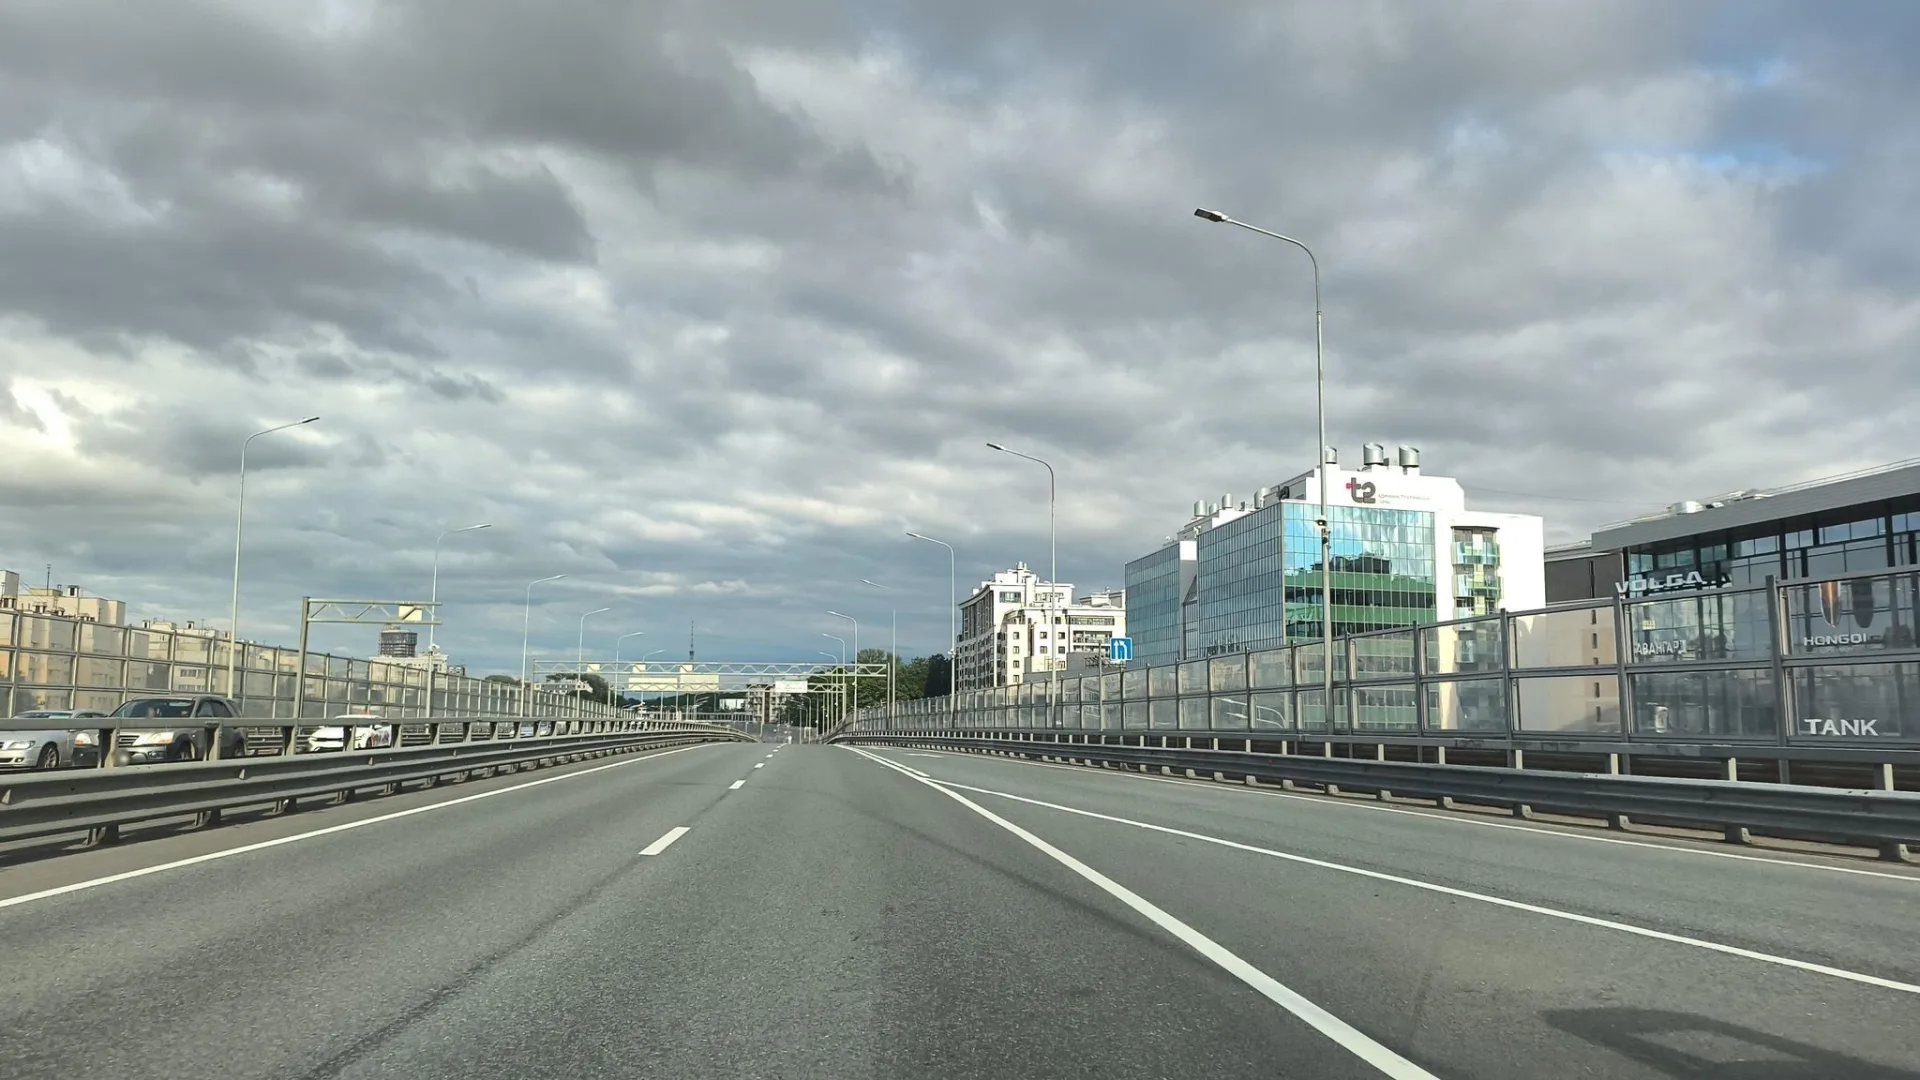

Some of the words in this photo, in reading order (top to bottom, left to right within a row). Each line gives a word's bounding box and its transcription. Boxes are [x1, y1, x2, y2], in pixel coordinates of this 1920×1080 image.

[1345, 477, 1376, 504] t2
[1615, 571, 1703, 593] VOLGA
[1803, 718, 1879, 736] TANK
